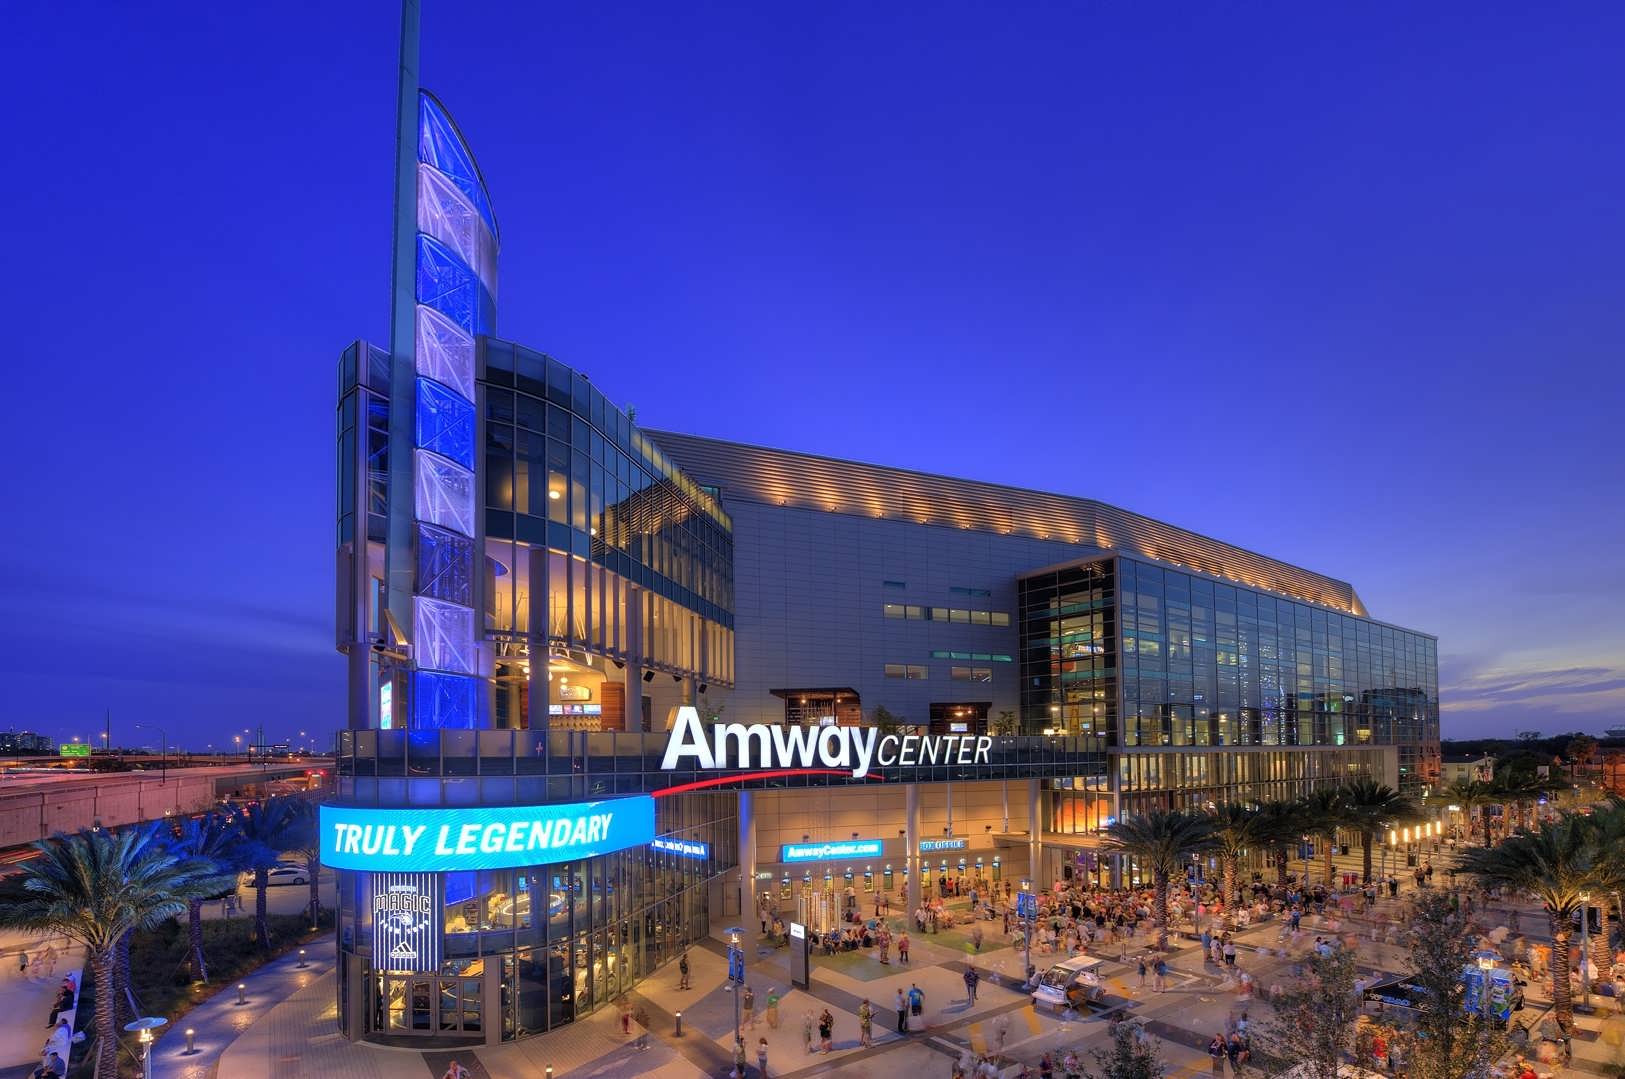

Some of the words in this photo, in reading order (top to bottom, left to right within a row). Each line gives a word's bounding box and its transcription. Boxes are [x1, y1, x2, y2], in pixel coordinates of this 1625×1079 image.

[660, 706, 878, 778] Amway
[877, 735, 992, 766] CENTER
[334, 823, 426, 856] TRULY
[434, 813, 613, 856] LEGENDARY
[374, 893, 431, 914] MAGIC
